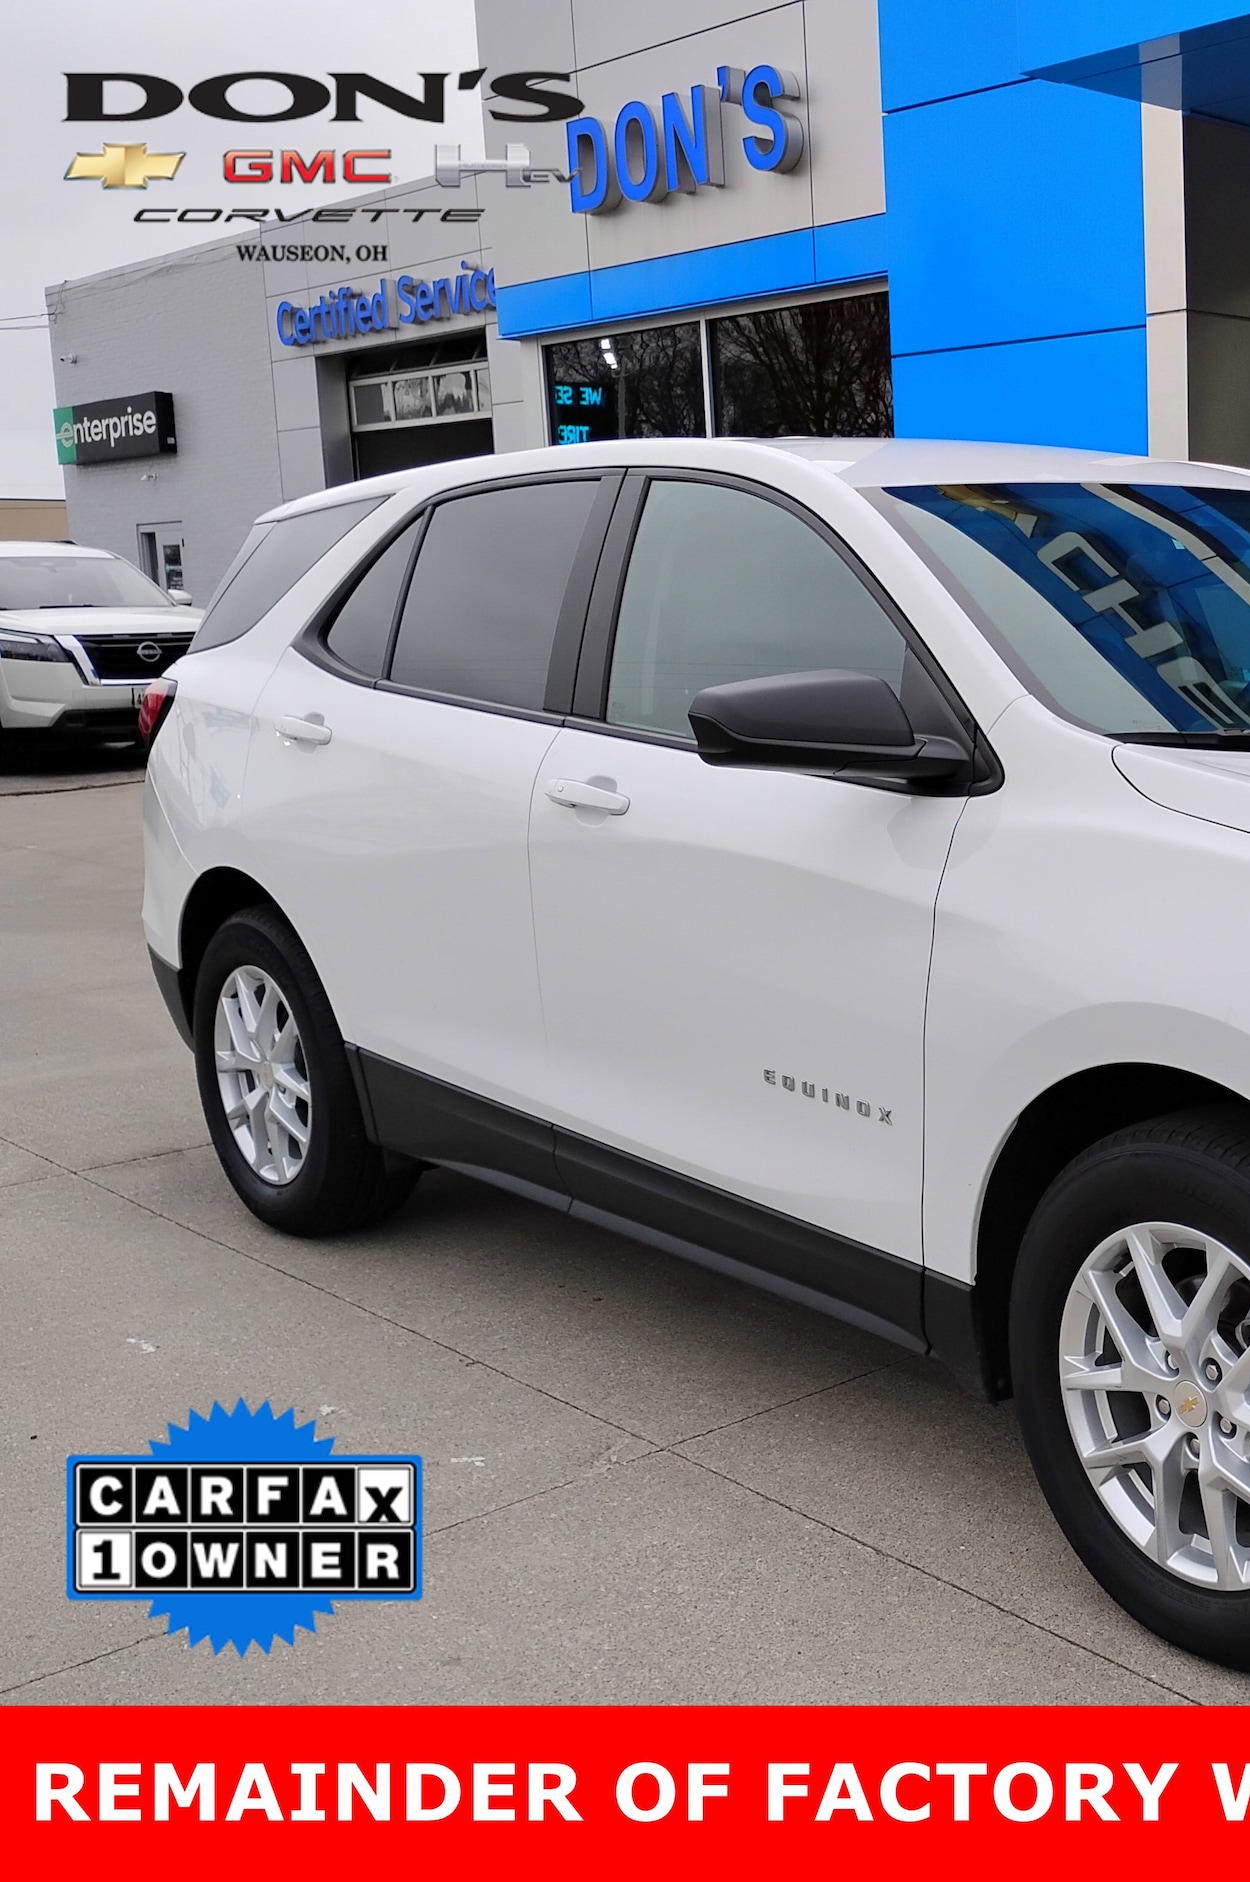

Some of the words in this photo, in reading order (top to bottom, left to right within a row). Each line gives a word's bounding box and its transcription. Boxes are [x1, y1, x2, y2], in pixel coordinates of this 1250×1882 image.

[567, 64, 796, 214] DON'S
[276, 278, 388, 346] Certified
[57, 406, 157, 448] enterprise
[763, 1068, 893, 1126] EQUINOX
